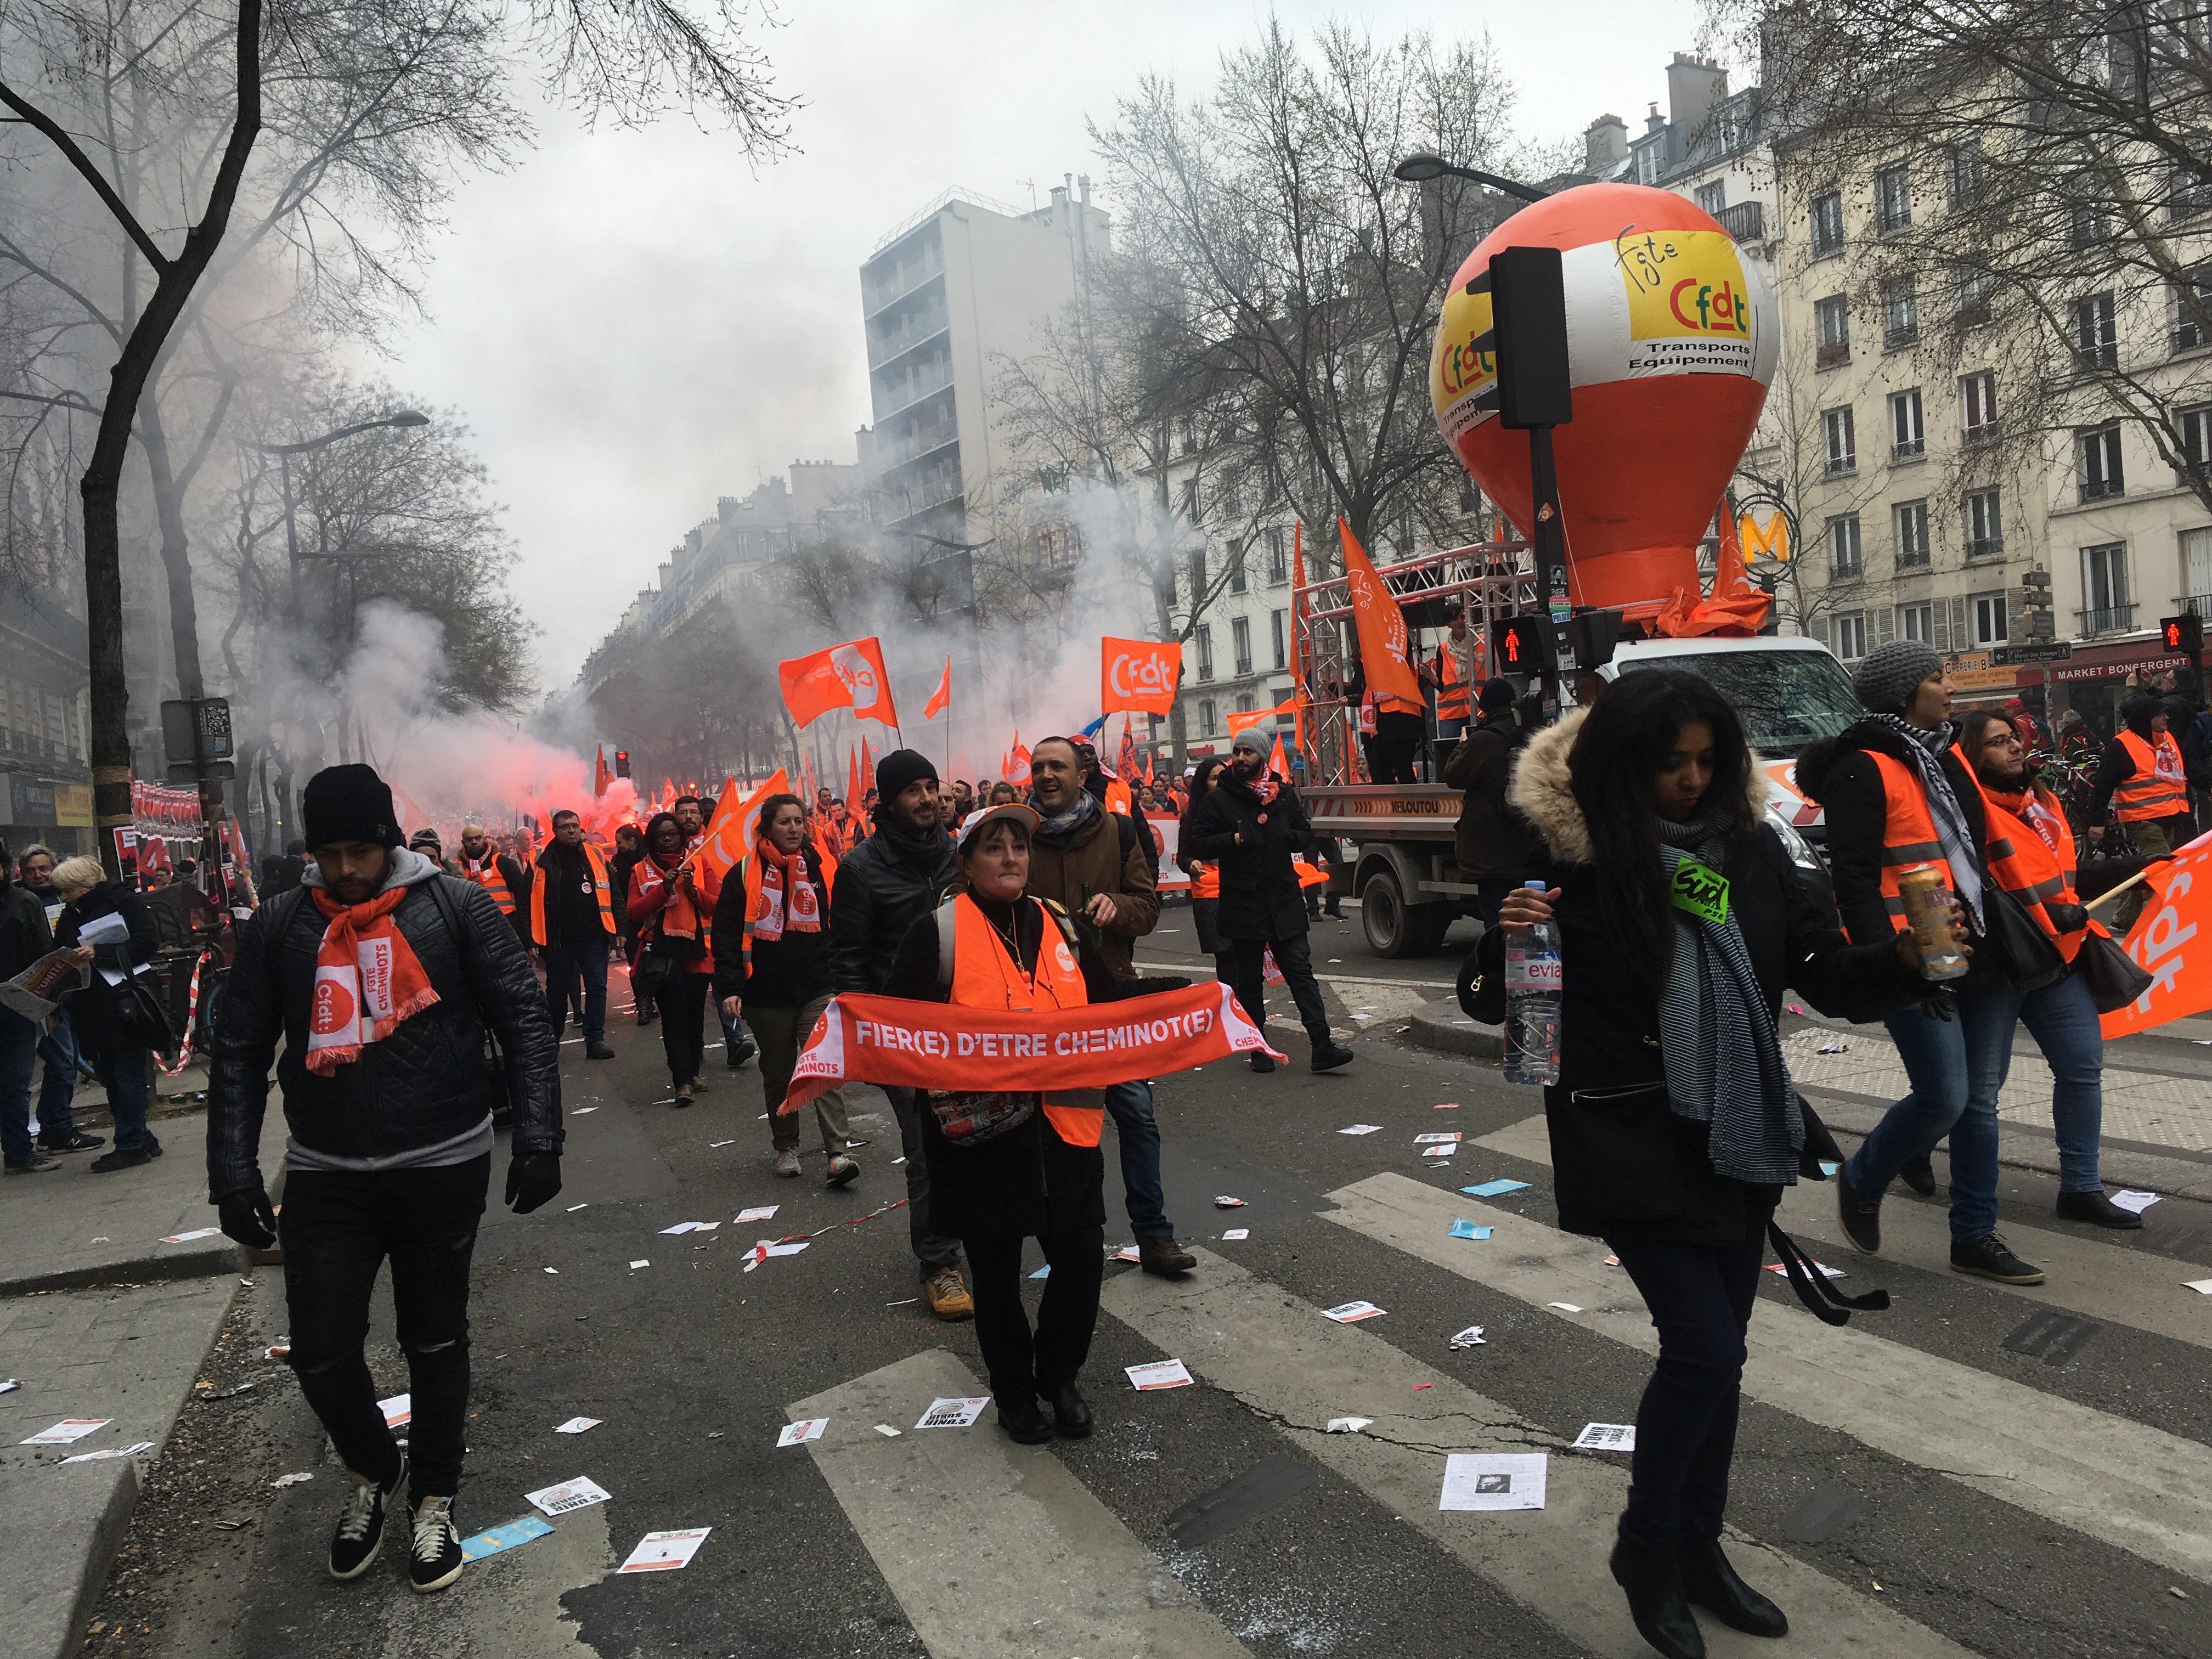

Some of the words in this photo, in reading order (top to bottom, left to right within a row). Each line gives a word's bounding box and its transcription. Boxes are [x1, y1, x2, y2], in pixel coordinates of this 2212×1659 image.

[1670, 278, 1747, 333] Cfdt
[1645, 342, 1751, 354] Transports
[1629, 356, 1749, 369] Equipement
[1446, 410, 1483, 440] Equipem
[1740, 511, 1788, 564] M
[1110, 653, 1172, 697] Cfdt
[2058, 667, 2103, 679] MARKET
[1703, 908, 1725, 920] PSE
[366, 967, 376, 994] FGTE
[376, 944, 388, 1011] CHEMINOTS
[1528, 962, 1562, 978] evia
[856, 1020, 950, 1059] FIER(E)
[957, 1032, 1047, 1057] D'ETRE
[1054, 1007, 1213, 1056] CHEMINOT(E)
[797, 1062, 839, 1075] MINOTS
[551, 1494, 602, 1512] S'UNIR
